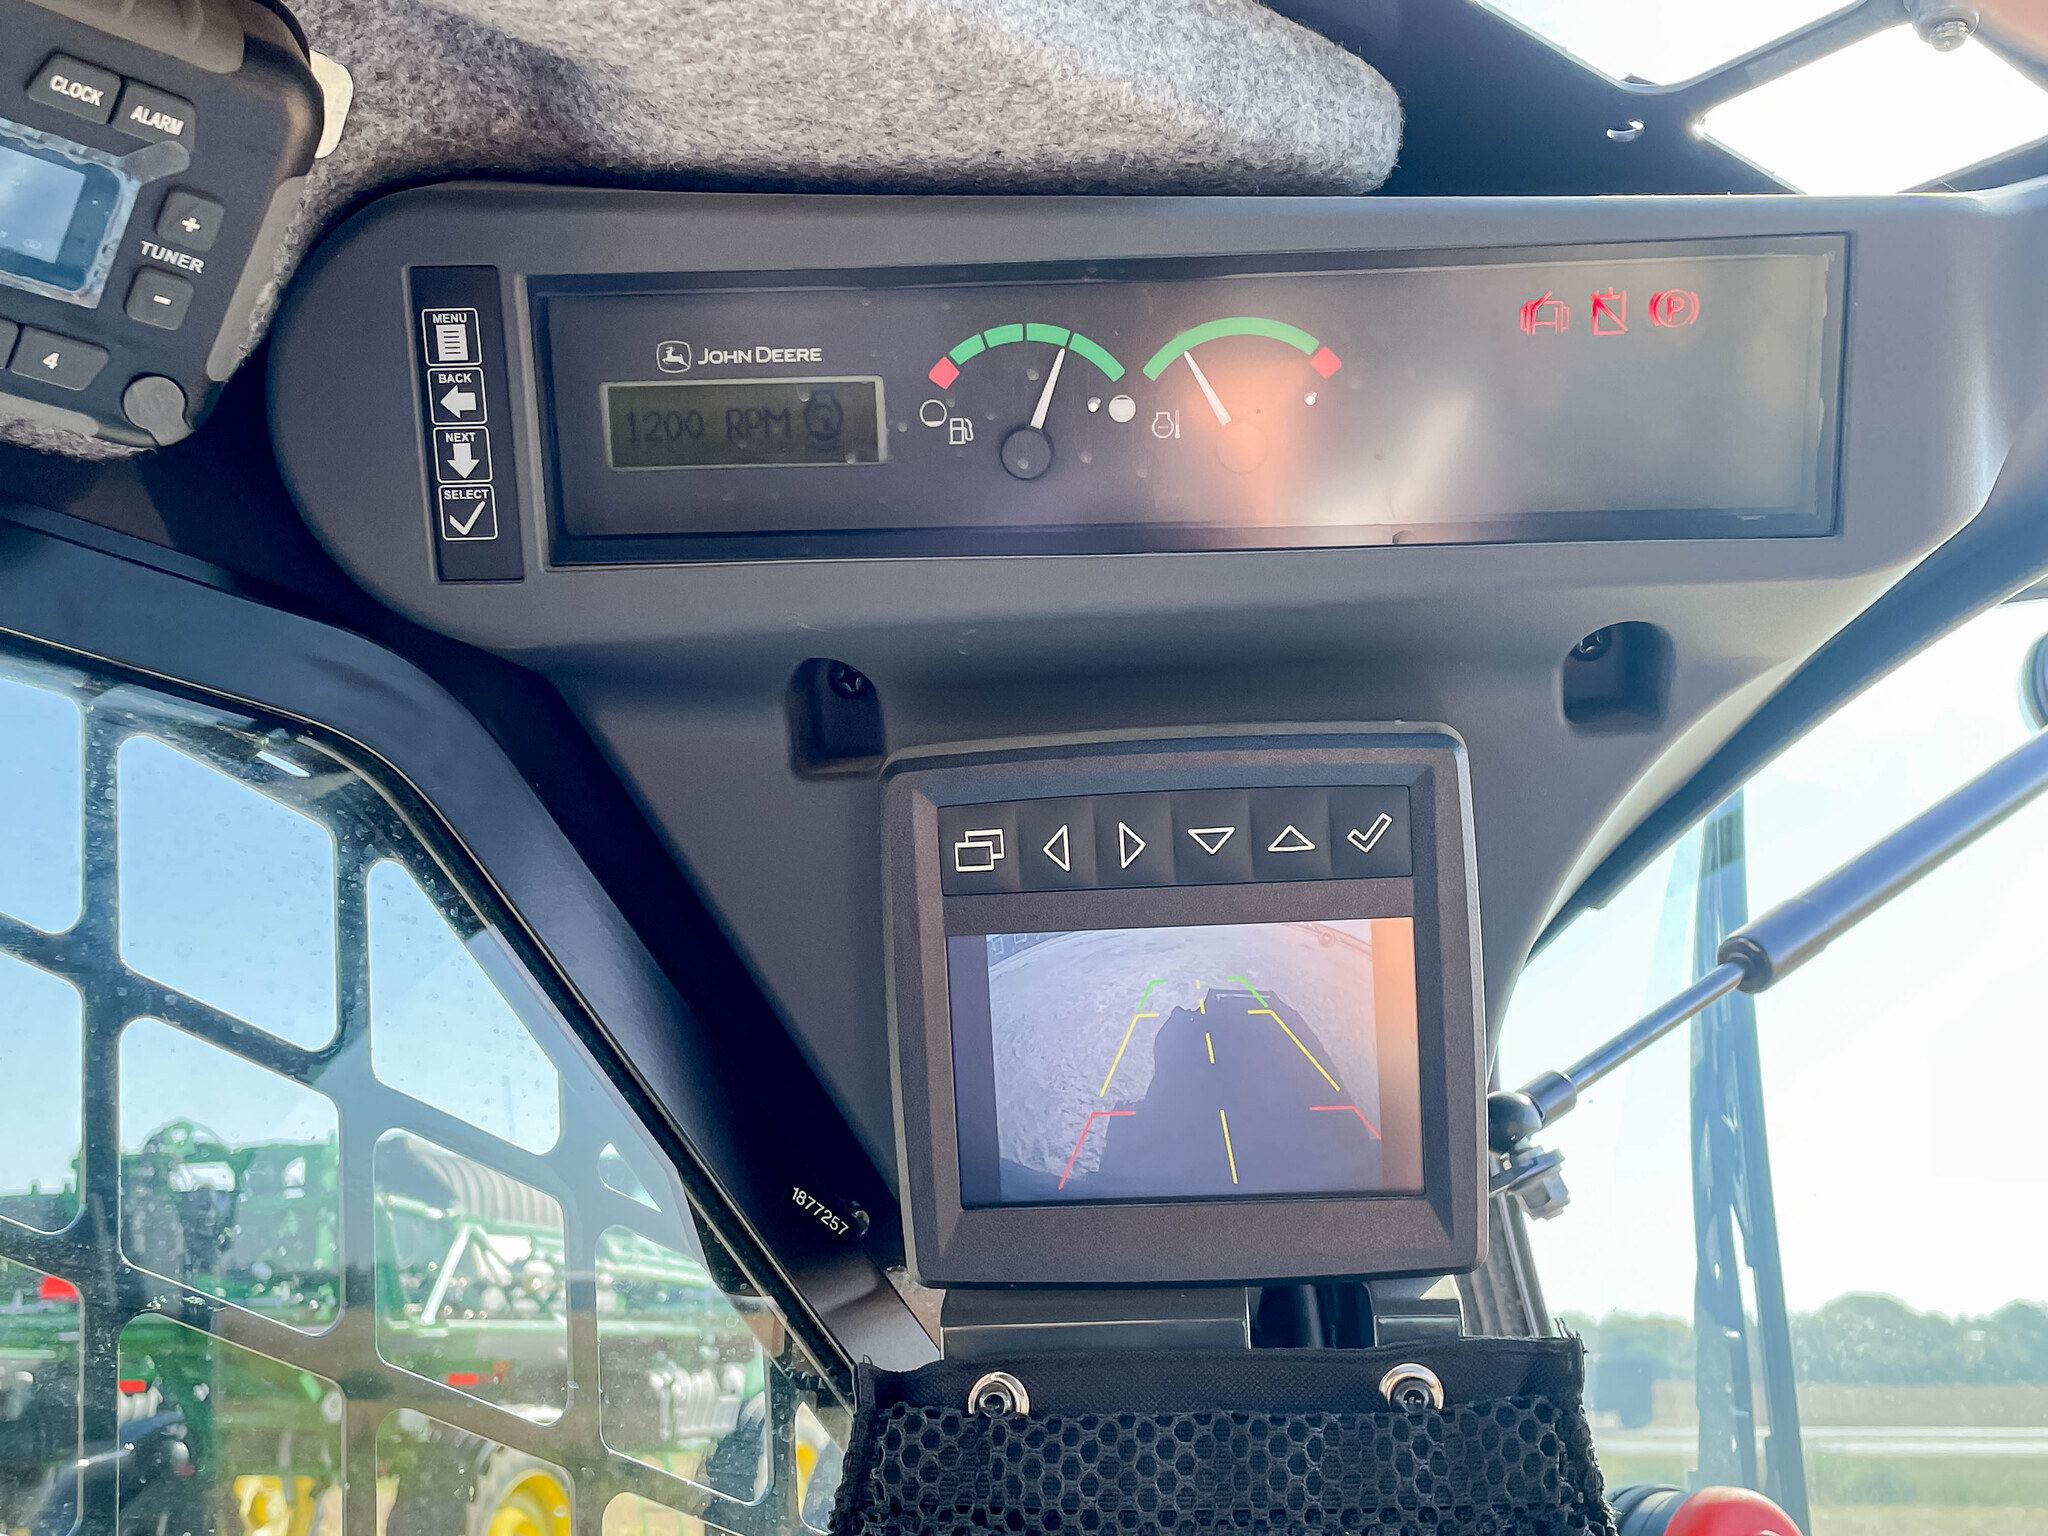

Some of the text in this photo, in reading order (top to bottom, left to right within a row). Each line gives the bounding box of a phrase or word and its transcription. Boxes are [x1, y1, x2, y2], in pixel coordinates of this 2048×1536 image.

[50, 74, 104, 107] CLOCK
[130, 105, 184, 137] ALARM
[140, 241, 205, 274] TUNER
[432, 313, 467, 324] MENU
[42, 352, 60, 369] 4
[697, 346, 823, 365] JOHN DEERE
[438, 373, 472, 384] BACK
[626, 407, 792, 444] 1200 RPM
[445, 432, 476, 443] NEXT
[443, 489, 489, 500] SELECT
[792, 1186, 850, 1235] 1877257
